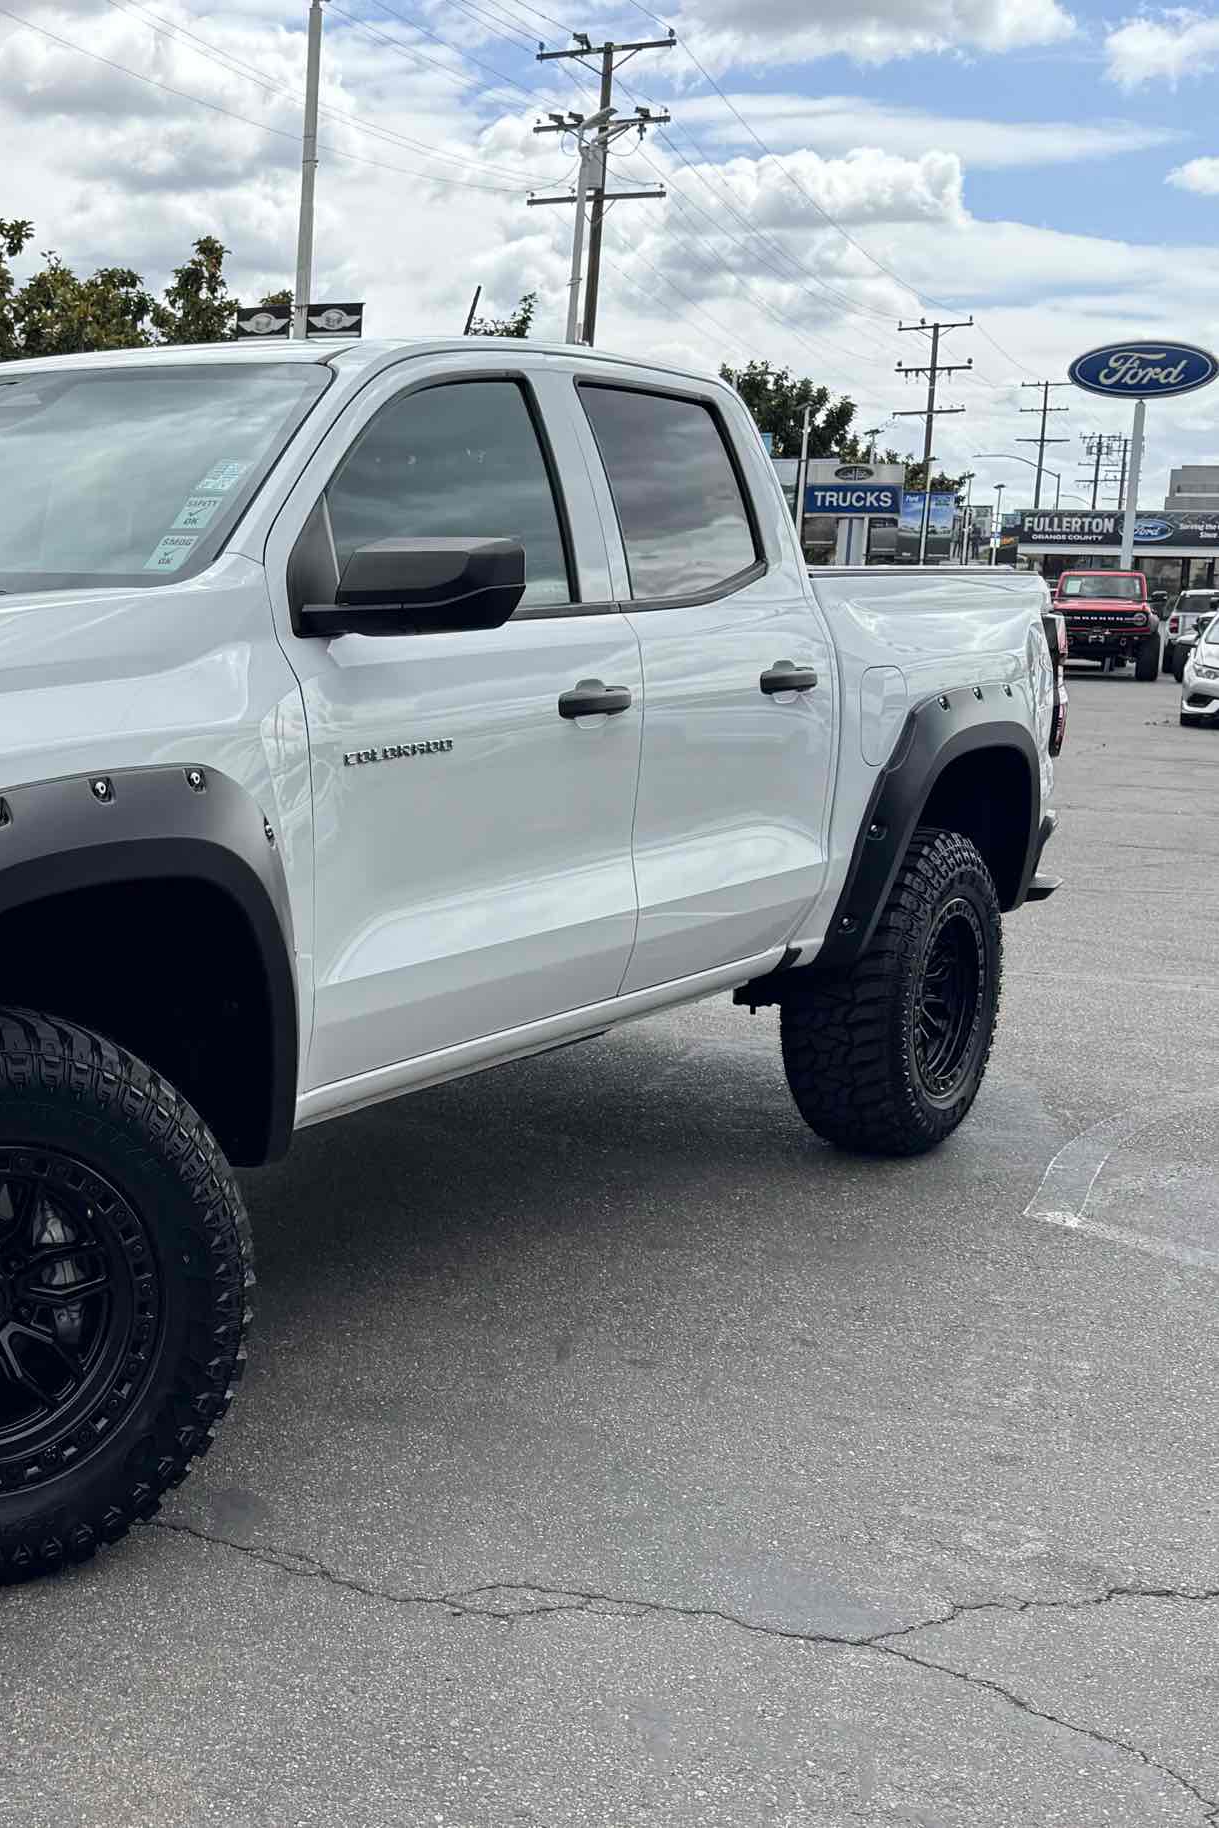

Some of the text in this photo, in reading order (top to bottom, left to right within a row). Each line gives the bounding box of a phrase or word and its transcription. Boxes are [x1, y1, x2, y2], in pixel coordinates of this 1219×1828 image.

[1099, 352, 1187, 385] Ford
[813, 491, 892, 507] TRUCKS
[1024, 517, 1115, 533] FULLERTON
[342, 737, 454, 767] COLORADO
